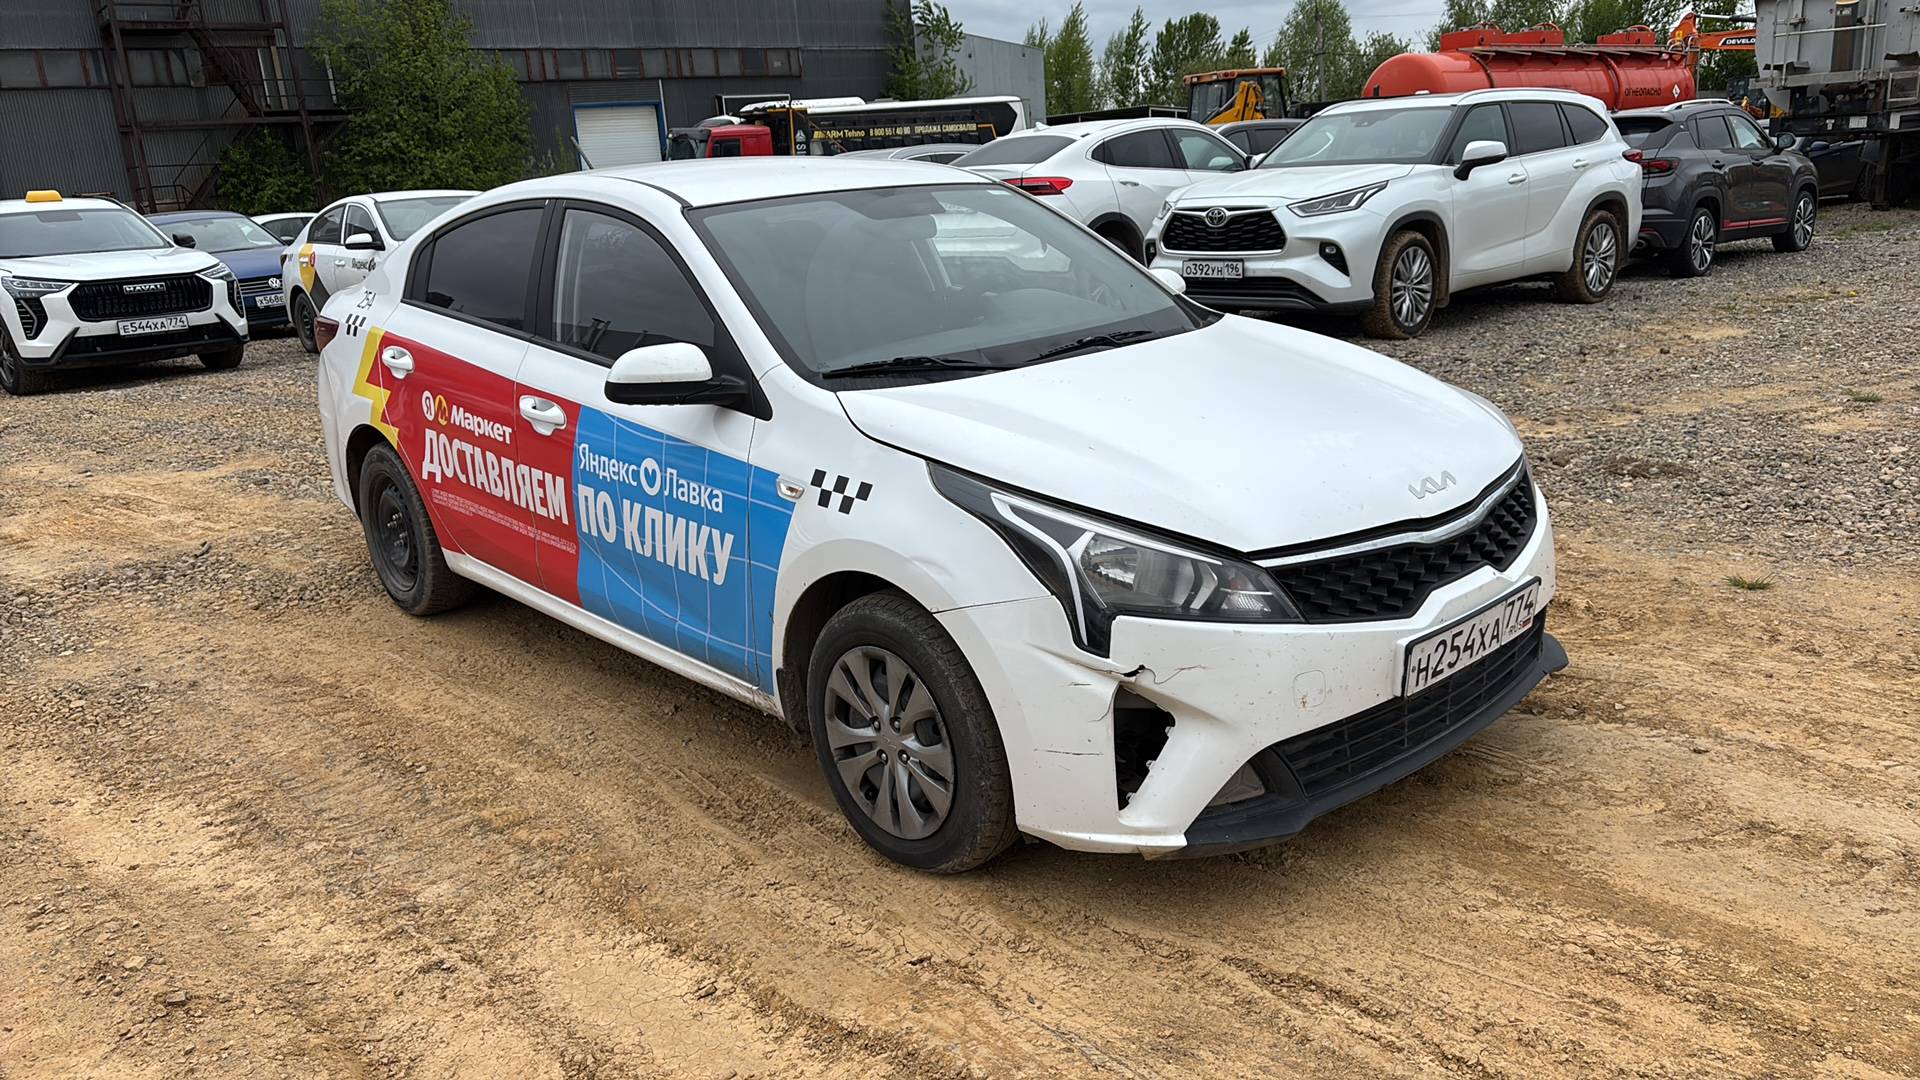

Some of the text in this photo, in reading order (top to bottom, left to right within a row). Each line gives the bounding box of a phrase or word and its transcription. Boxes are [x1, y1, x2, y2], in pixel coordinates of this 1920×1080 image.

[1624, 87, 1662, 97] ОГНЕОПАСНО
[844, 129, 865, 138] Tehno
[1185, 263, 1240, 276] О392УН 196
[125, 283, 165, 292] HAVAL
[122, 316, 185, 334] Е544ХА 774
[450, 405, 512, 444] Маркет
[422, 428, 569, 525] ДОСТАВЛЯЕМ
[578, 443, 723, 513] Яндекс Лавка
[578, 484, 617, 543] ПО
[623, 499, 734, 586] КЛИКУ
[1416, 590, 1534, 687] Н254ХА 774
